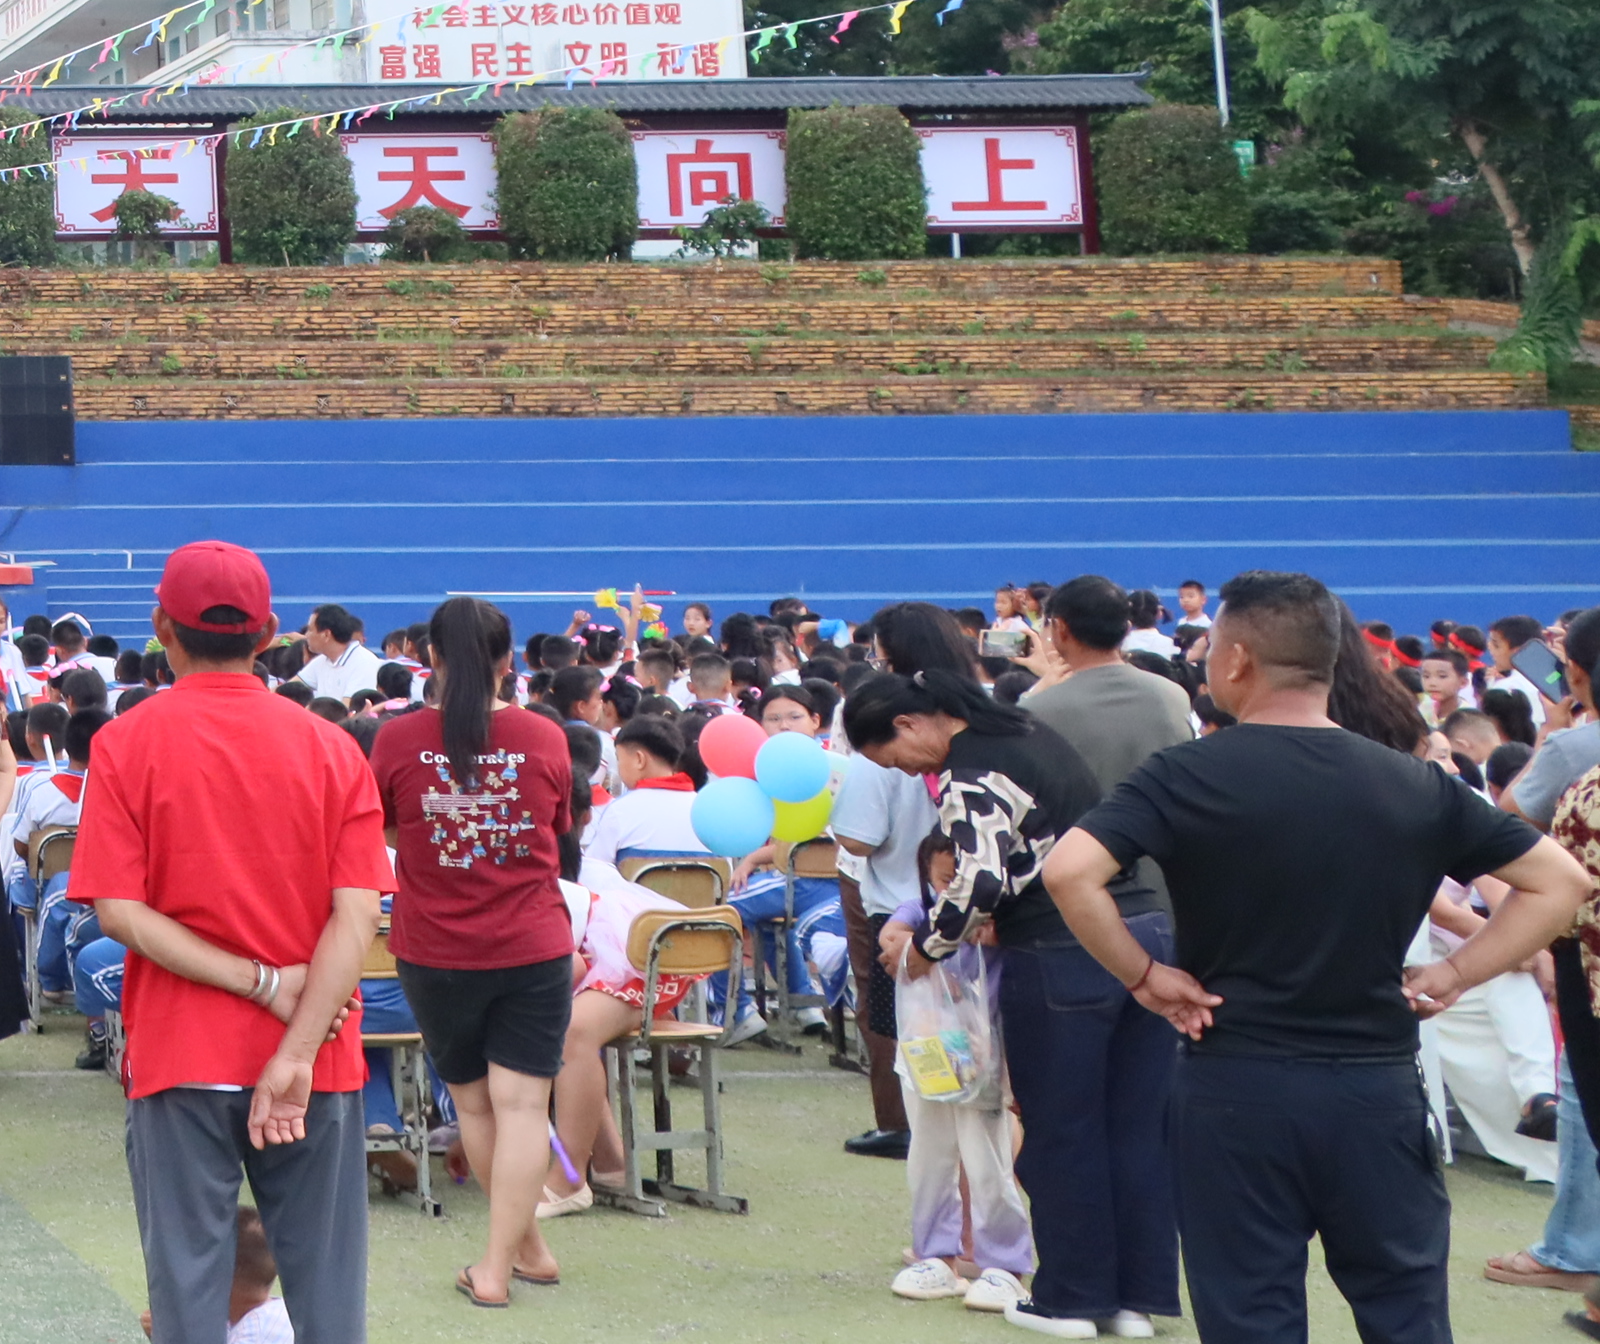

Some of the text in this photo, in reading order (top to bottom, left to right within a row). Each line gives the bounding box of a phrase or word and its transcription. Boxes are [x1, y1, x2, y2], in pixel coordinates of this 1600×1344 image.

[411, 3, 682, 30] 社会主义核心价值观
[379, 41, 720, 78] 富强 民主 文明 和谐
[90, 138, 1047, 223] 天 天 向 上
